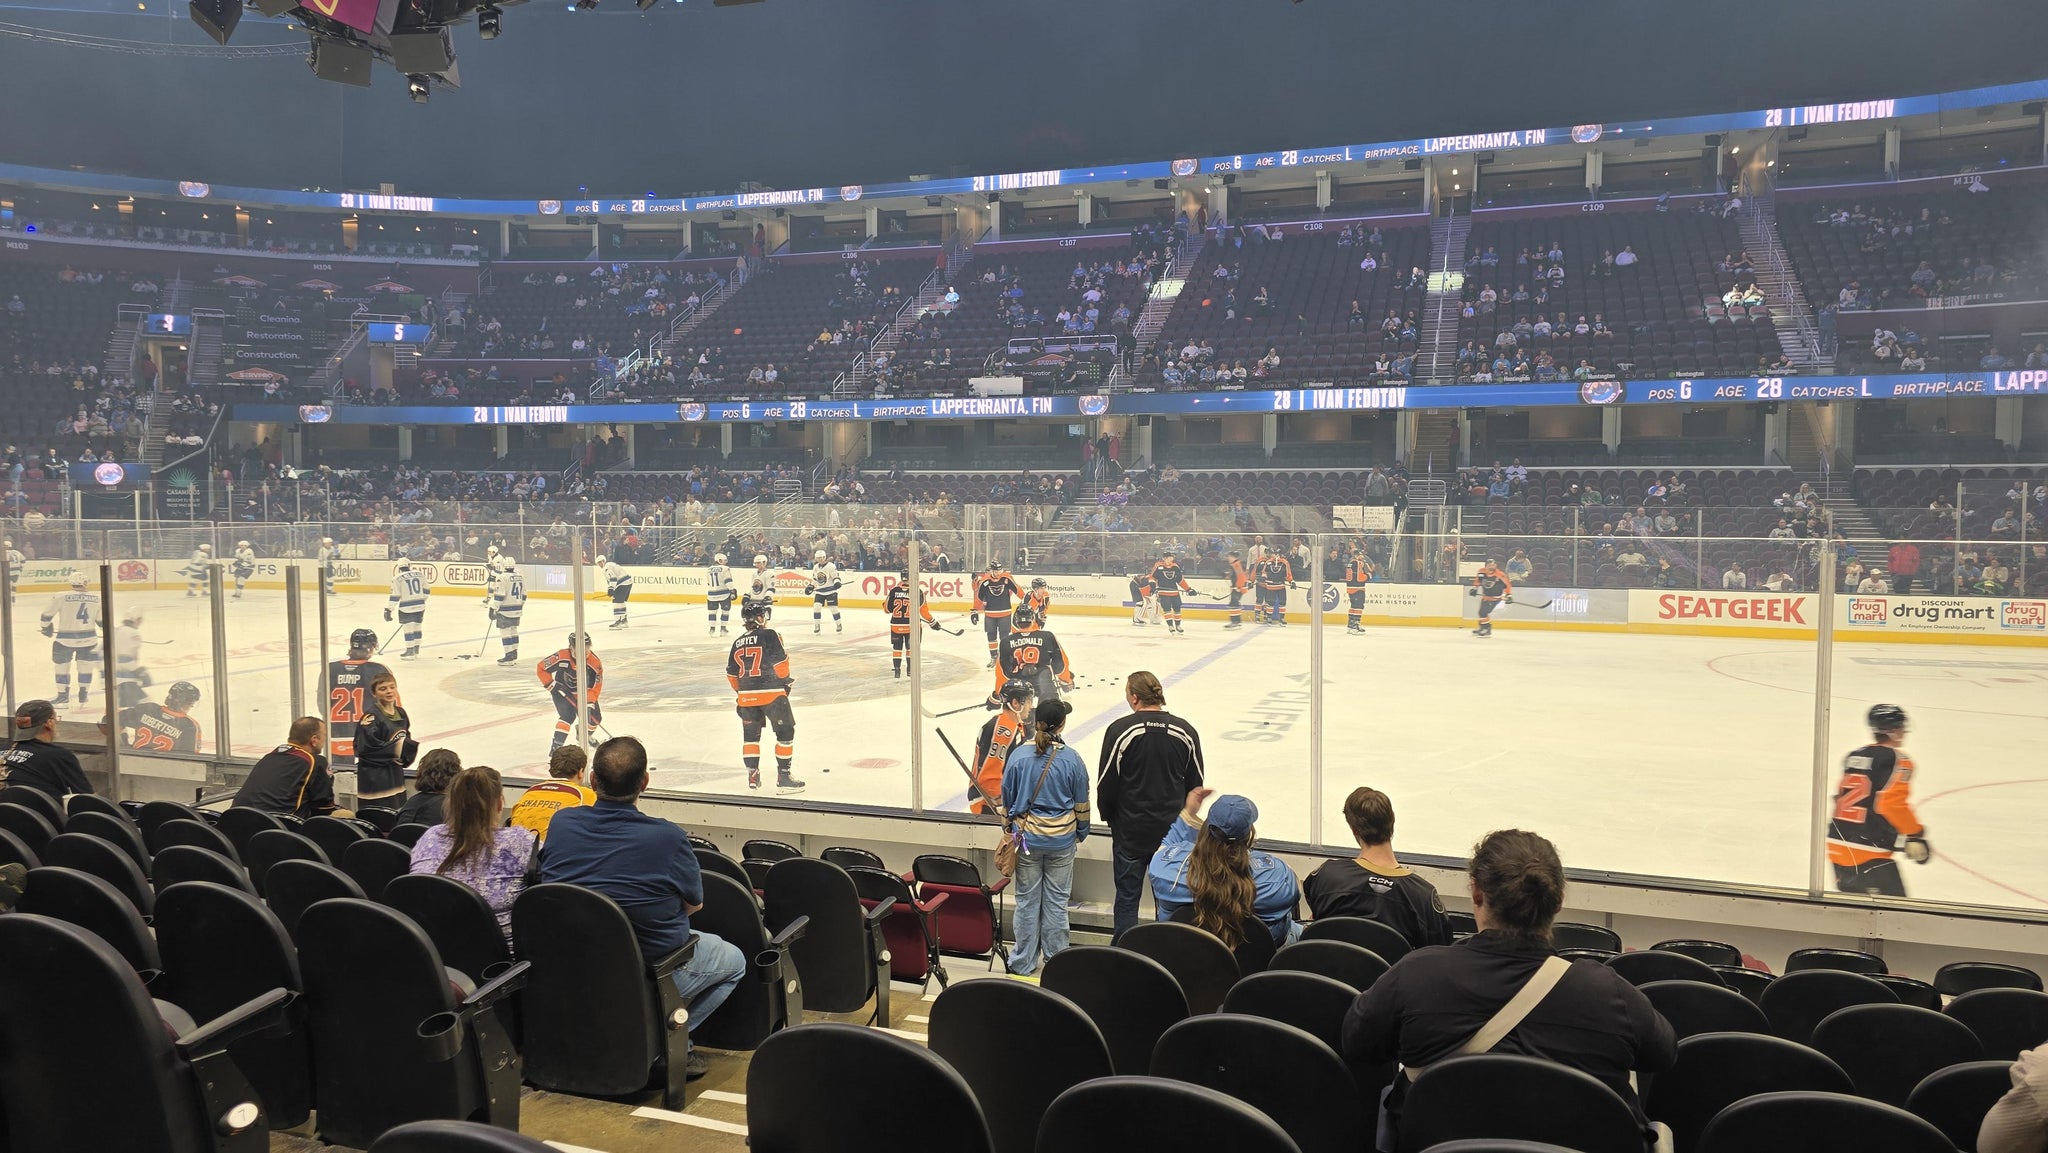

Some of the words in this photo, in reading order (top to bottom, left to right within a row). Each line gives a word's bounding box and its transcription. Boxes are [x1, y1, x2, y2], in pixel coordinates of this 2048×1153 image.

[1765, 109, 1782, 126] 28
[1804, 104, 1833, 124] IVAN
[1838, 99, 1895, 122] FEDOTOV
[1215, 162, 1232, 170] POS:
[1256, 157, 1276, 167] AGE:
[1282, 151, 1298, 165] 28
[1303, 153, 1341, 163] CATCHES:
[1345, 147, 1352, 160] L
[1365, 146, 1419, 158] BIRTHPLACE:
[1424, 132, 1521, 153] LAPPEENRANTA,
[1525, 129, 1545, 144] FIN
[973, 177, 984, 191] 28
[999, 172, 1020, 189] IVAN
[369, 195, 391, 210] IVAN
[611, 204, 627, 212] AGE:
[632, 200, 645, 212] 28
[650, 204, 680, 212] CATCHES:
[682, 200, 688, 211] L
[696, 200, 735, 210] BIRTHPLACE:
[738, 190, 806, 206] LAPPEENRANTA,
[809, 188, 823, 201] FIN
[247, 332, 304, 344] Restoration.
[394, 323, 404, 341] 5
[236, 350, 300, 363] Construction.
[1766, 368, 1797, 376] Huntington
[1648, 389, 1677, 400] POS:
[1680, 380, 1691, 399] G
[1715, 386, 1747, 398] AGE:
[1756, 378, 1782, 398] 28
[1791, 386, 1858, 398] CATCHES:
[1861, 378, 1873, 397] L
[1894, 380, 1987, 395] BIRTHPLACE:
[1274, 390, 1290, 410] 28
[1313, 389, 1343, 409] IVAN
[1347, 387, 1406, 408] FEDOTOV
[474, 406, 488, 423] 28
[504, 406, 526, 423] IVAN
[529, 406, 568, 423] FEDOTOV
[722, 409, 741, 418] POS:
[764, 408, 784, 417] AGE:
[790, 401, 806, 417] 28
[811, 409, 852, 417] CATCHES:
[854, 403, 861, 417] L
[873, 406, 928, 417] BIRTHPLACE:
[932, 398, 1028, 415] LAPPEENRANTA,
[1032, 397, 1052, 413] FIN
[448, 567, 486, 582] RE-BATH
[633, 576, 664, 586] EDICAL
[665, 575, 703, 586] MUTUAL
[710, 572, 720, 587] 11
[405, 578, 421, 595] 10
[775, 579, 810, 587] ERVPRO
[76, 602, 89, 625] 4
[1658, 593, 1806, 625] SEATGEEK
[1851, 601, 1880, 613] drug
[1892, 603, 1939, 622] drug
[1944, 606, 1994, 620] mart
[2004, 603, 2038, 616] drug
[1854, 612, 1886, 621] mart
[2007, 615, 2042, 625] mart
[736, 635, 758, 648] GURYEV
[1009, 637, 1043, 649] McDONALD
[733, 646, 763, 679] 57
[337, 674, 361, 685] BUMP
[330, 687, 365, 723] 21
[140, 714, 183, 739] ROBERTSON
[522, 799, 562, 811] SNAPPER
[1368, 876, 1394, 886] CCM
